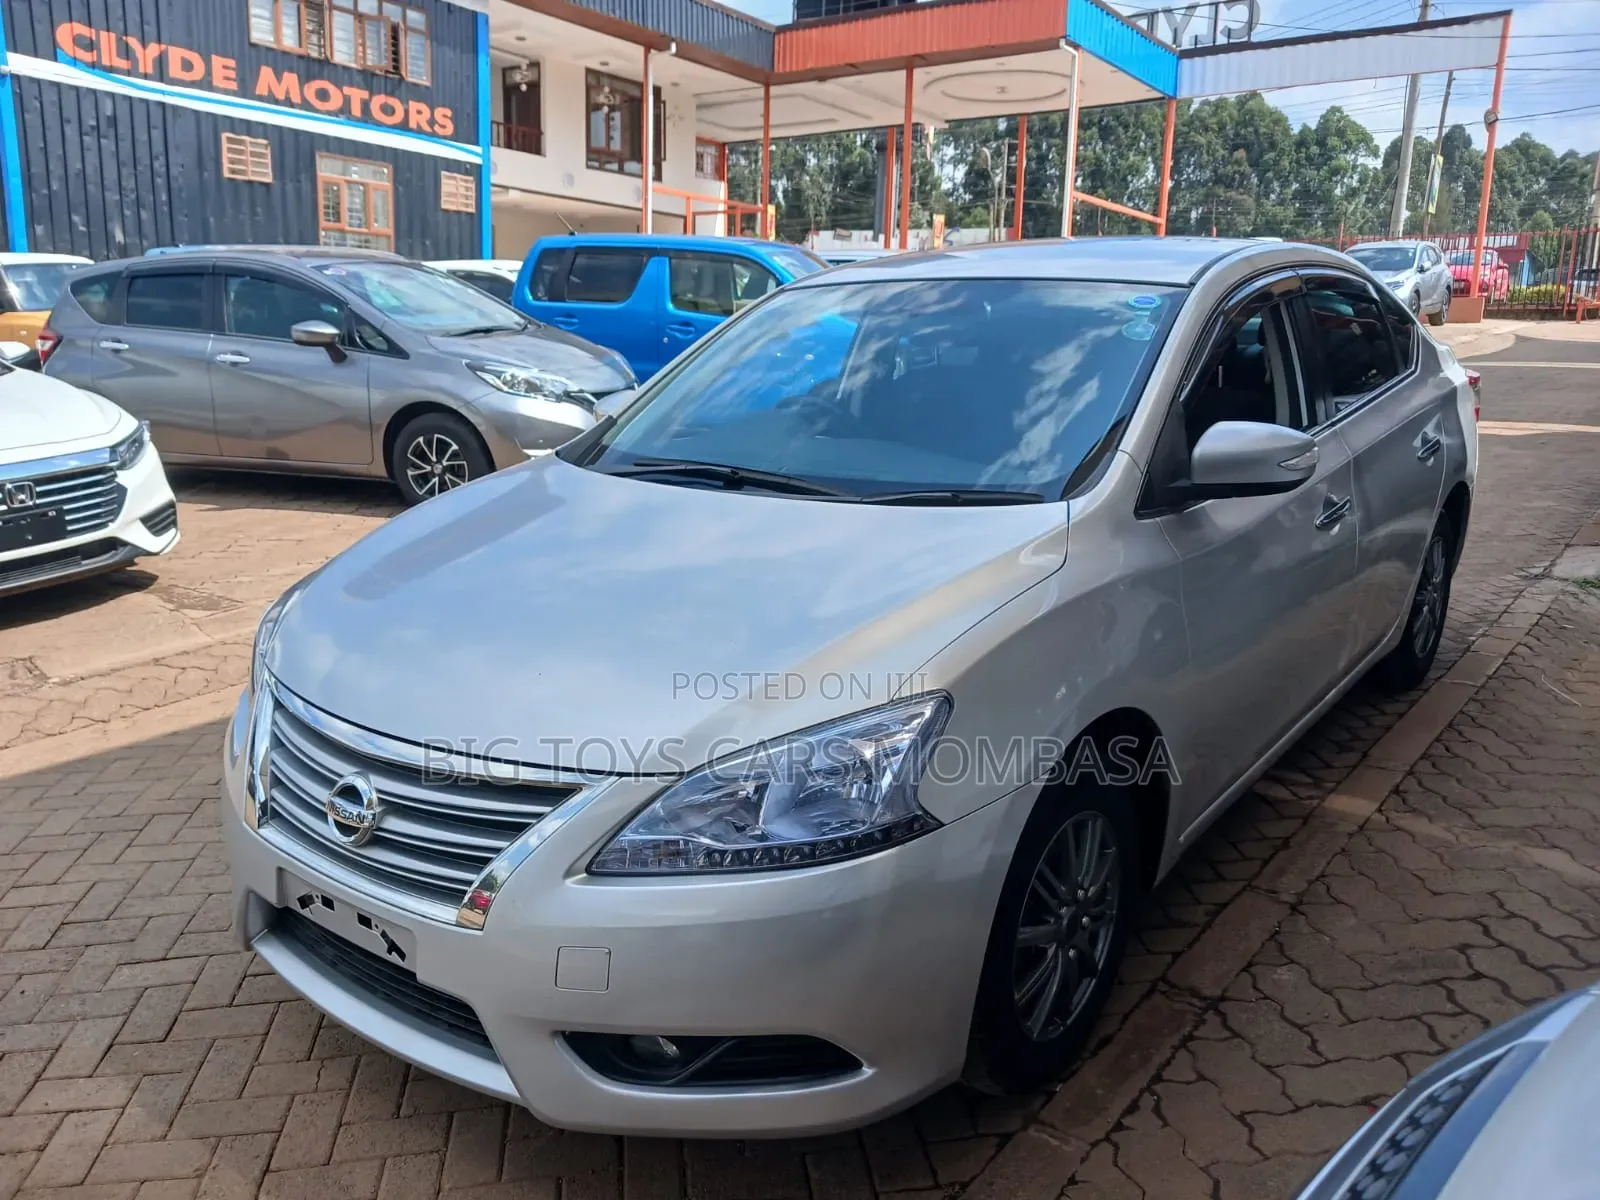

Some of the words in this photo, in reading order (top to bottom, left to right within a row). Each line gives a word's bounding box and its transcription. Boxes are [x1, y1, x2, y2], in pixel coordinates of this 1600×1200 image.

[55, 21, 238, 90] CLYDE
[255, 64, 454, 136] MOTORS
[327, 799, 366, 824] NISSAN
